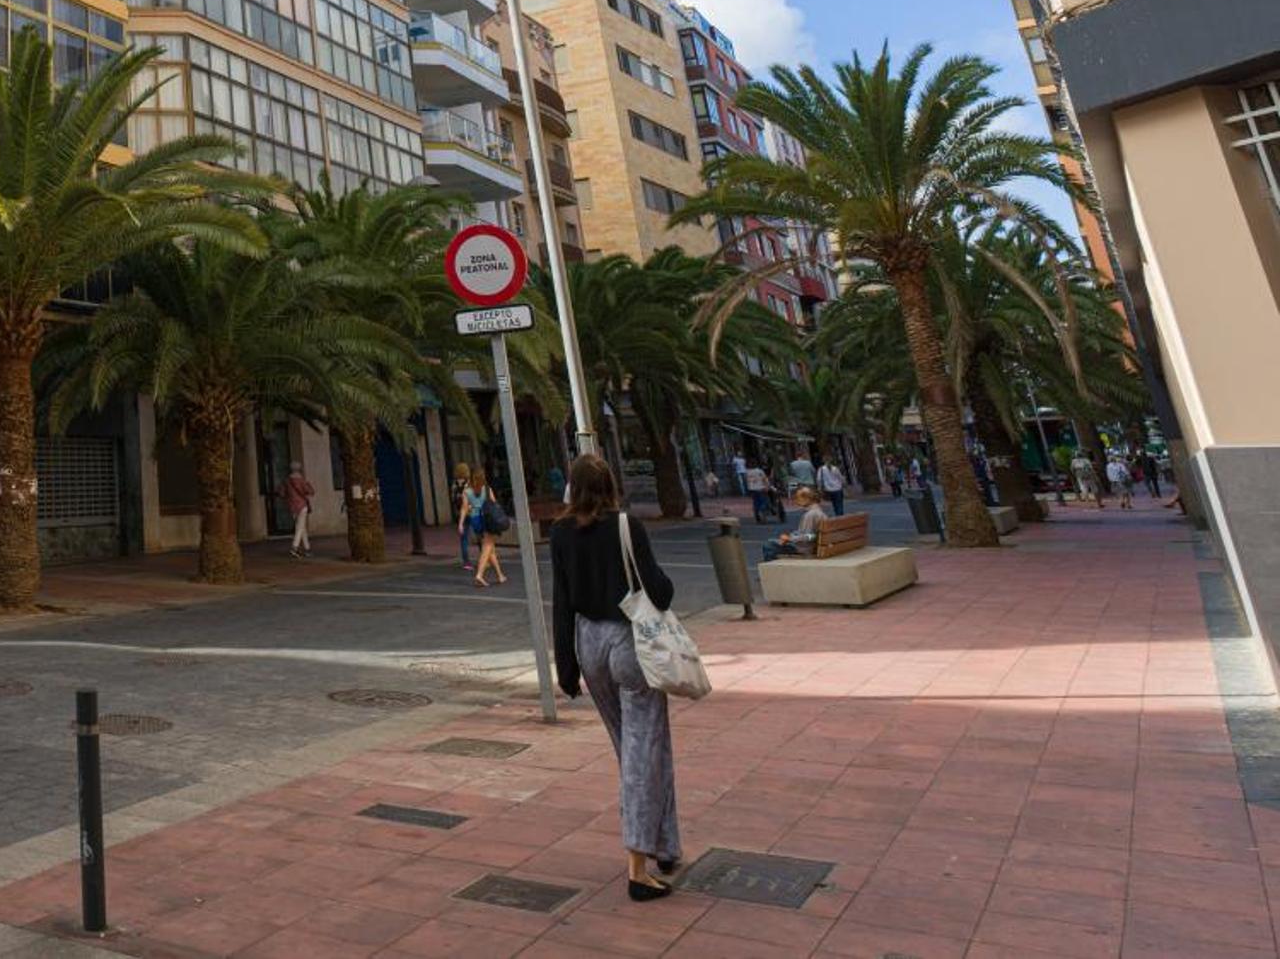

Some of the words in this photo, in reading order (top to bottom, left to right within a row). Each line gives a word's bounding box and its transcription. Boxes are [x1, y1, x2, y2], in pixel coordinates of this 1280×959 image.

[470, 253, 496, 264] ZONA
[460, 262, 509, 274] PEATONAL
[473, 309, 513, 322] EXCEPTO
[467, 317, 521, 331] BICICLETAS
